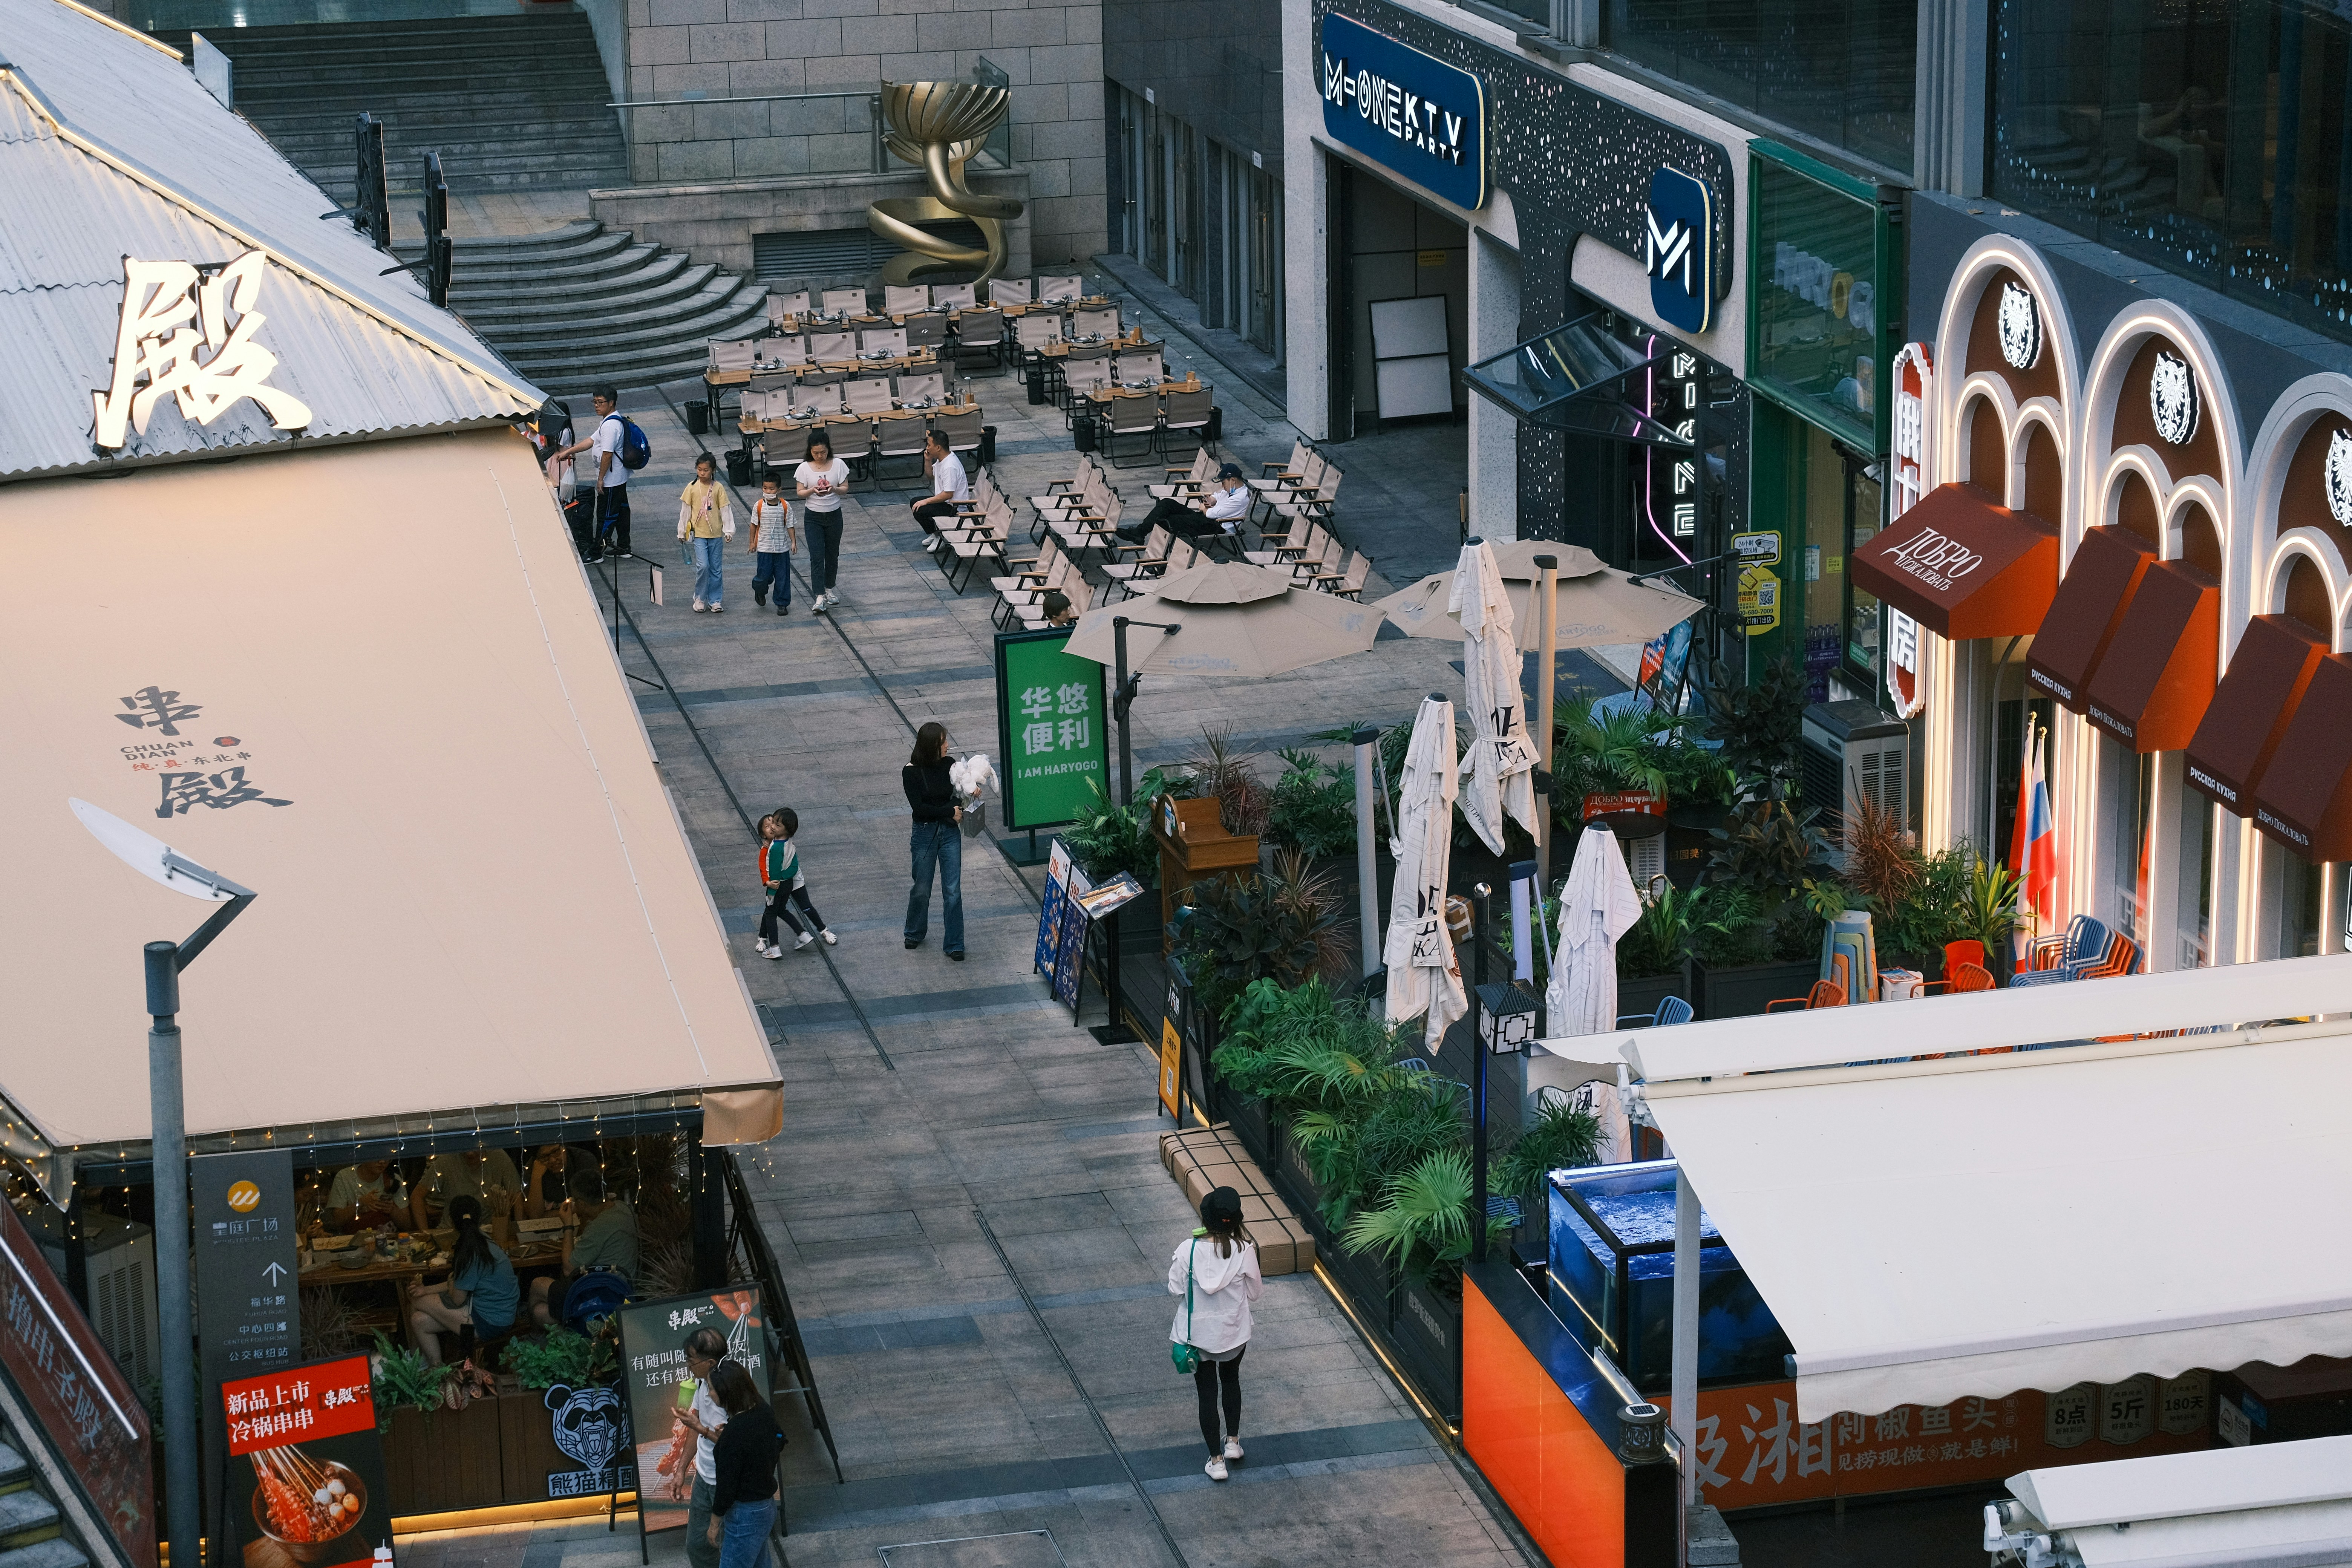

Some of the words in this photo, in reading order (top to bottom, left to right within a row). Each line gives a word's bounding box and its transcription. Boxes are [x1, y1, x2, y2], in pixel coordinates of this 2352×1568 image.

[1405, 126, 1459, 165] PARTY
[93, 249, 312, 448] 殿
[1881, 526, 1983, 578] ДОБРО
[1894, 556, 1954, 591] ПОЖАЛОВАТЬ
[1020, 682, 1089, 719] 华悠
[2054, 682, 2071, 701] КУХНЯ
[114, 685, 204, 737] 串
[2089, 705, 2103, 721] ДОБРО
[2103, 713, 2133, 738] ПОЖАЛОВАТЬ
[120, 740, 194, 753] CHUAN
[1022, 717, 1089, 755] 便利
[124, 749, 177, 761] DIAN
[1018, 769, 1021, 779] I
[1024, 768, 1041, 778] AM
[1044, 760, 1098, 775] HARYOGO
[155, 766, 295, 818] 殿
[1589, 795, 1623, 806] ДОБРО
[2216, 781, 2236, 802] КУХНЯ
[2257, 808, 2273, 825] ДОБРО
[2274, 818, 2309, 846] ПОЖАЛОВАТЬ
[1050, 855, 1059, 879] 298
[212, 1217, 278, 1237] 皇庭广场
[251, 1295, 286, 1307] 福华路
[239, 1321, 287, 1335] 中心四路
[668, 1308, 701, 1331] 串殿
[229, 1346, 288, 1361] 公交枢纽站
[227, 1380, 310, 1415] 新品上市
[325, 1387, 357, 1409] 串殿
[2110, 1397, 2145, 1420] 5斤
[2165, 1395, 2204, 1411] 180天
[231, 1408, 314, 1443] 冷锅串串
[2054, 1405, 2086, 1425] 8点
